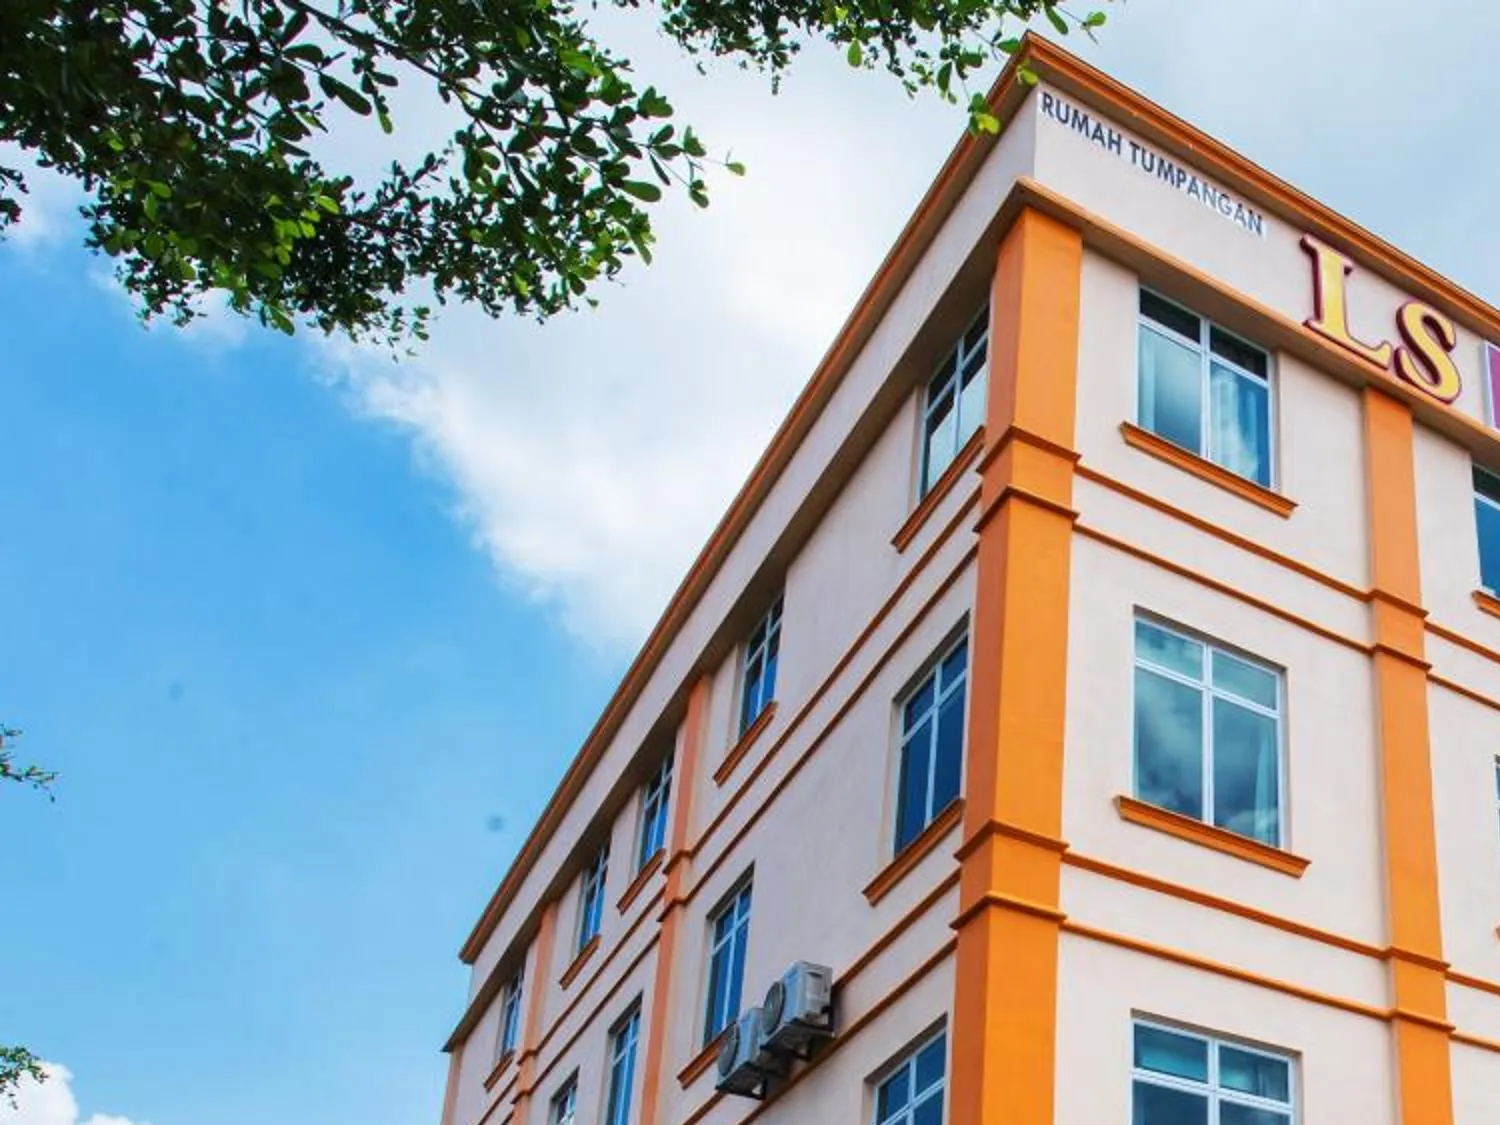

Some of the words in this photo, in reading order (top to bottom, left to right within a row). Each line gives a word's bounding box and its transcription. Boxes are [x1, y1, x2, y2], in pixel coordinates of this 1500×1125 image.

[1041, 92, 1122, 157] RUMAH
[1129, 138, 1264, 237] TUMPANGAN
[1300, 233, 1463, 405] LS
